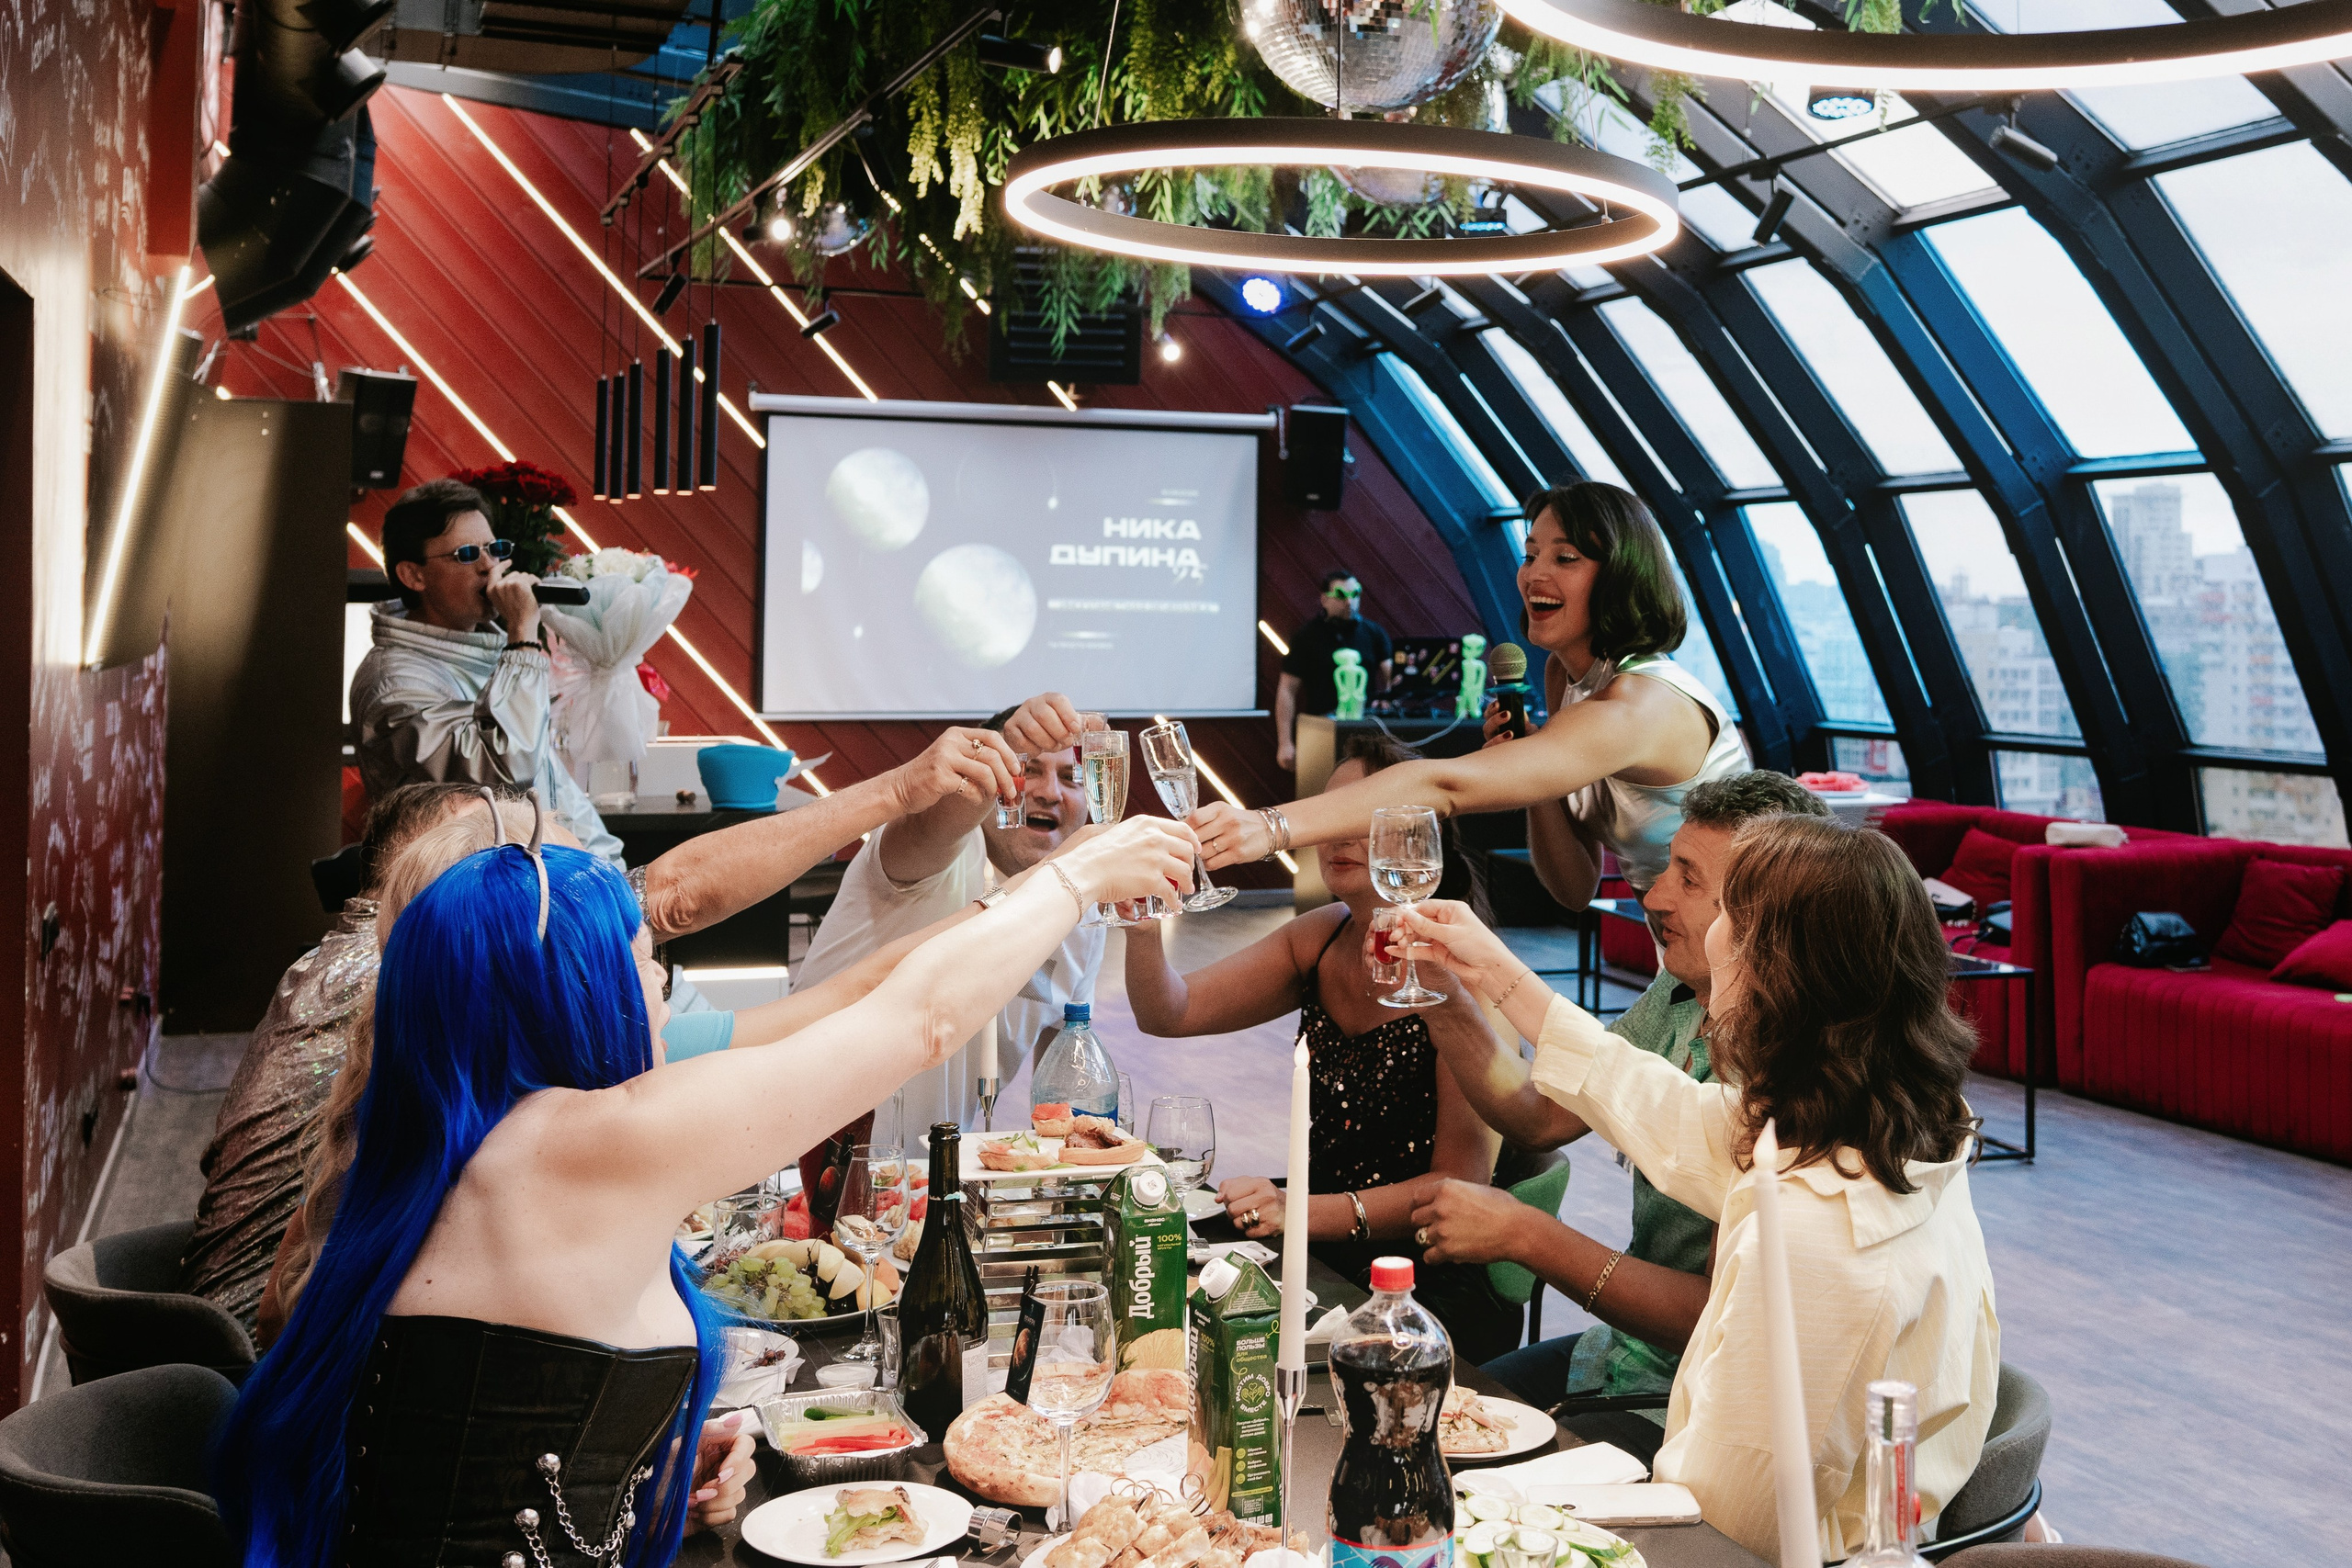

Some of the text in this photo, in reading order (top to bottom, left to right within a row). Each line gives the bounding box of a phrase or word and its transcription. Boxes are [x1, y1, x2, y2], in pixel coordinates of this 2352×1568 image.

[1103, 517, 1202, 540] НИКА
[1157, 1234, 1182, 1243] 100%
[1128, 1235, 1155, 1319] Добрый
[1201, 1333, 1215, 1348] 100%
[1237, 1337, 1265, 1346] БОЛЬШЕ
[1237, 1342, 1265, 1351] ПОЛЬЗЫ
[1235, 1373, 1271, 1414] РАСТИМ ДОБРО ВМЕСТЕ
